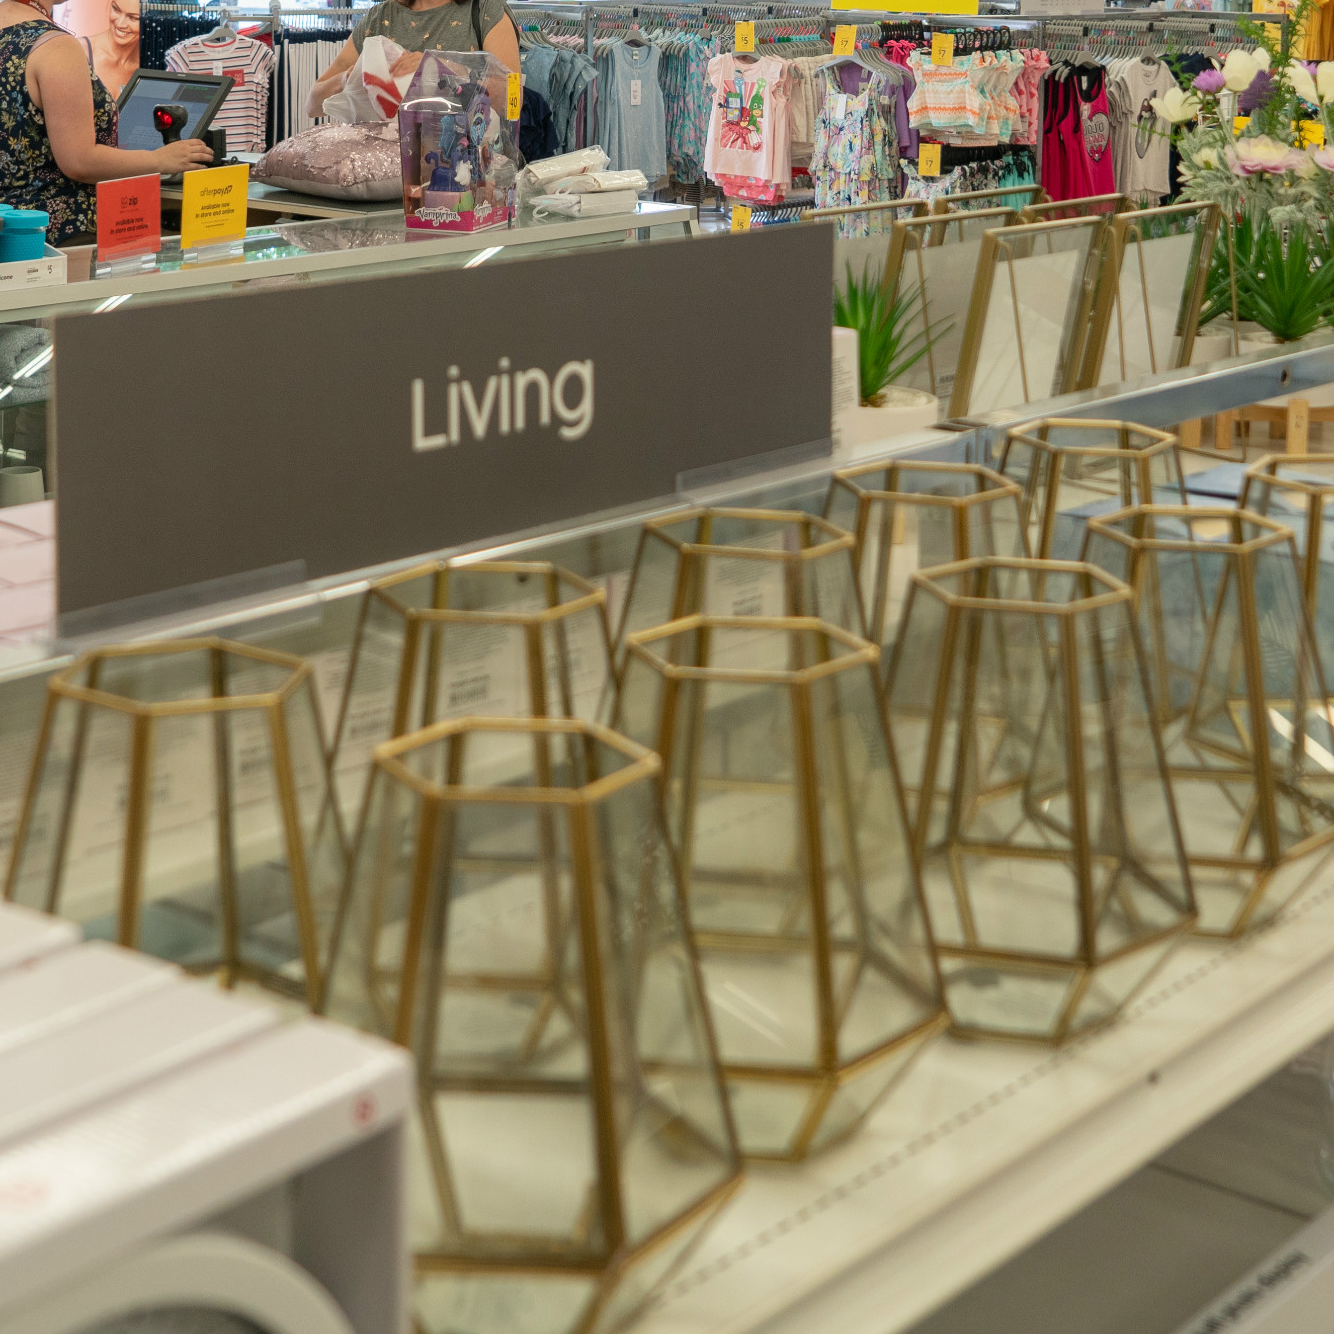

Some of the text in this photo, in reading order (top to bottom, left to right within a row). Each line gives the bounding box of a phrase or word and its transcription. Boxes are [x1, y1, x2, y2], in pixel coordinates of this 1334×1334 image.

[741, 37, 749, 45] $5
[840, 39, 848, 48] $7
[938, 49, 946, 57] $7
[200, 186, 224, 198] afterpay
[128, 196, 138, 206] zip
[201, 203, 220, 211] Available
[47, 264, 53, 274] $5
[411, 357, 594, 452] Living
